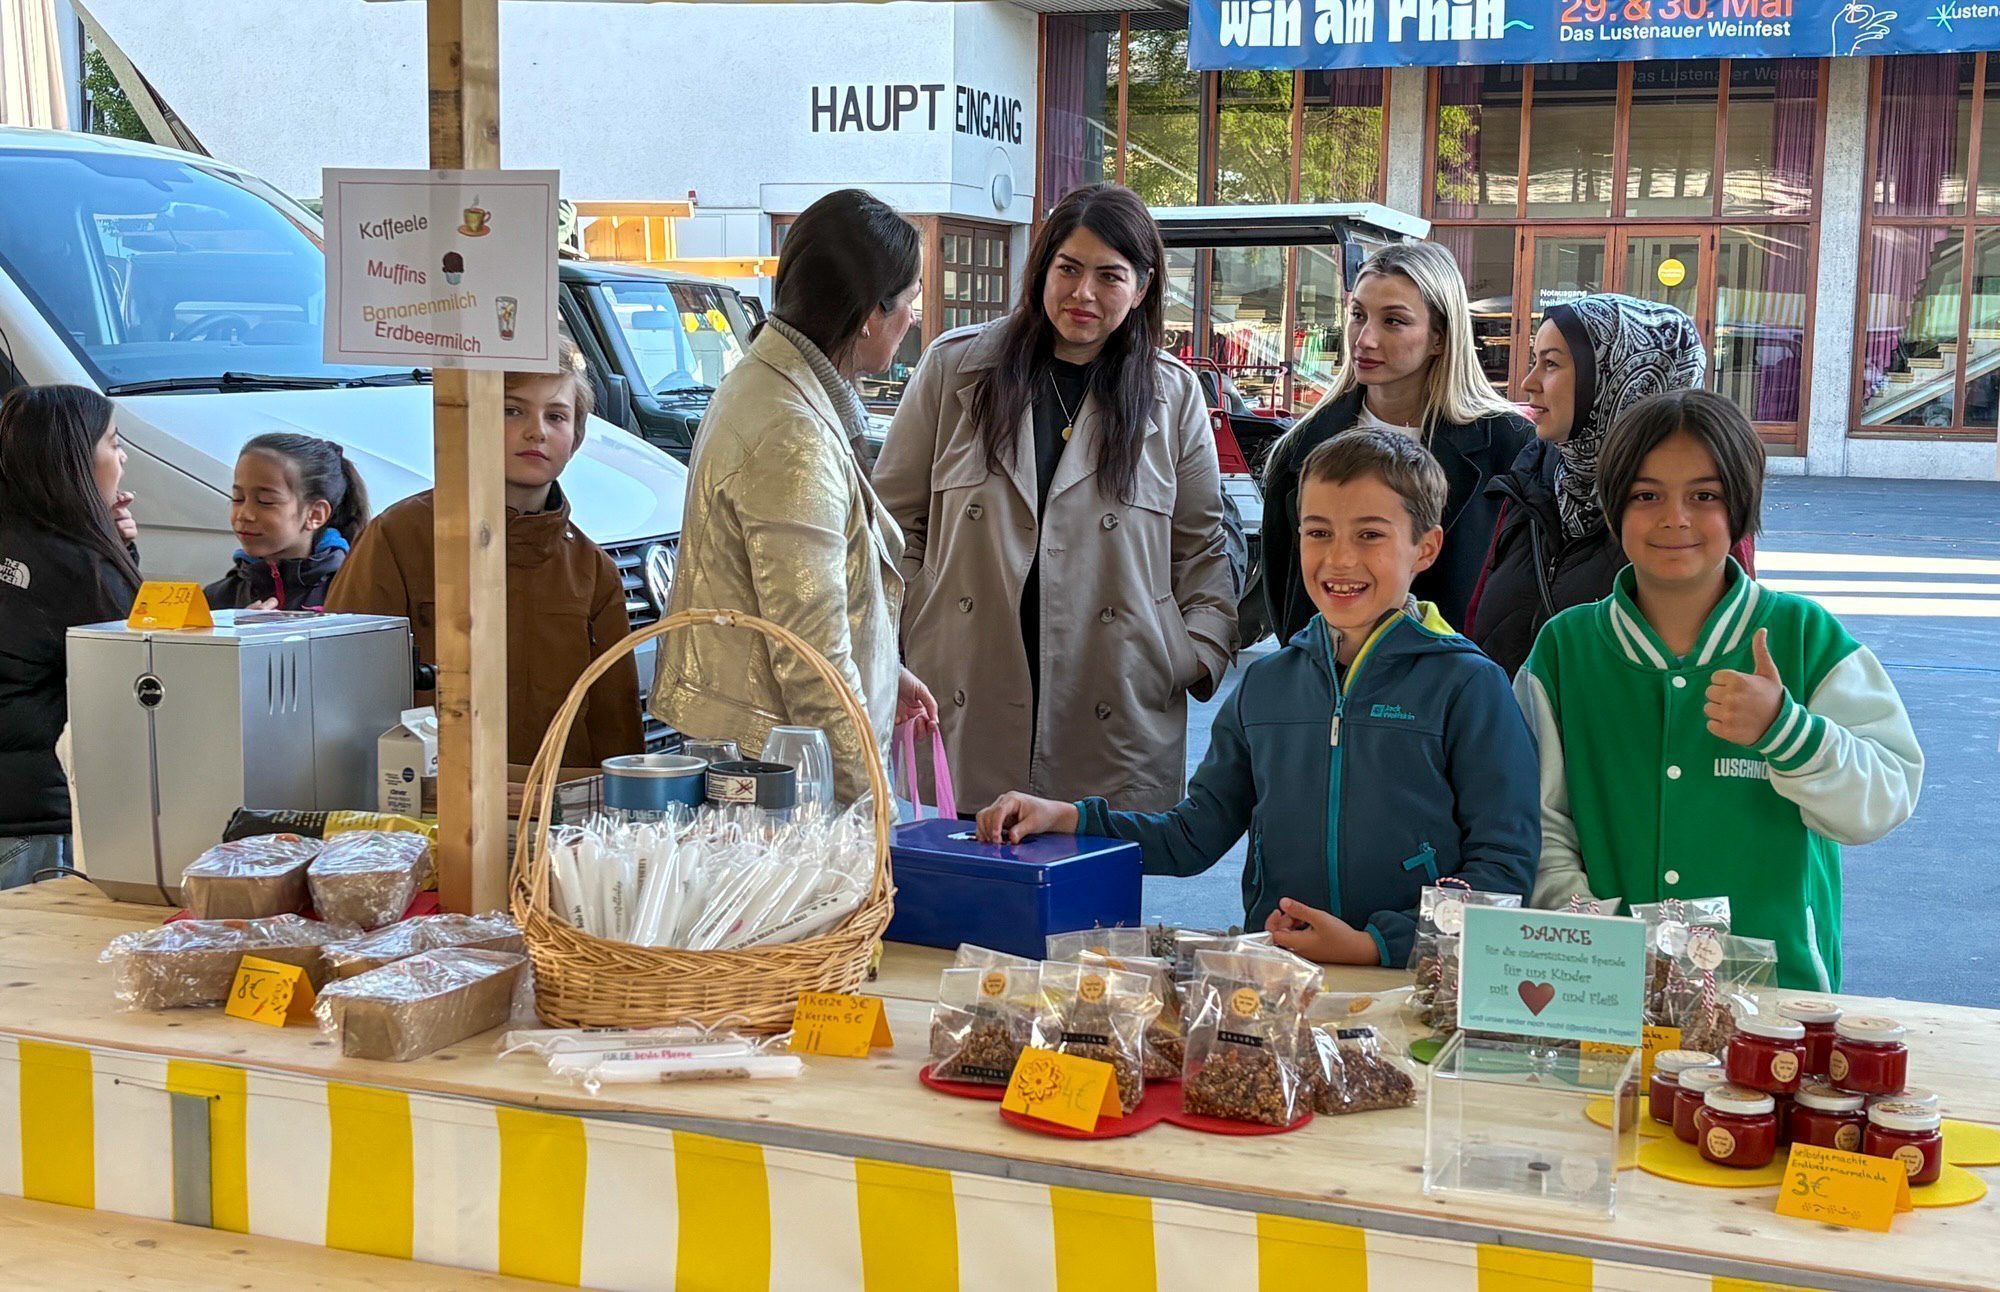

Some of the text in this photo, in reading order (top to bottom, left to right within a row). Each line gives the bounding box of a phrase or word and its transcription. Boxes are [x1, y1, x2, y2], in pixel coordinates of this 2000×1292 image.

[1219, 0, 1302, 47] win
[1314, 0, 1374, 45] am
[1942, 4, 2000, 19] Lusten
[1560, 21, 1791, 42] Das Lustenauer Weinfest
[811, 84, 946, 133] HAUPT
[955, 84, 1022, 145] EINGANG
[359, 214, 428, 241] Kaffeele
[367, 259, 427, 285] Muffins
[363, 291, 478, 323] Bananenmilch
[375, 320, 482, 353] Erdbeermilch
[1520, 924, 1593, 946] DANKE
[237, 974, 266, 1000] 8€
[1550, 968, 1593, 984] Kinder
[1792, 1172, 1831, 1198] 3€
